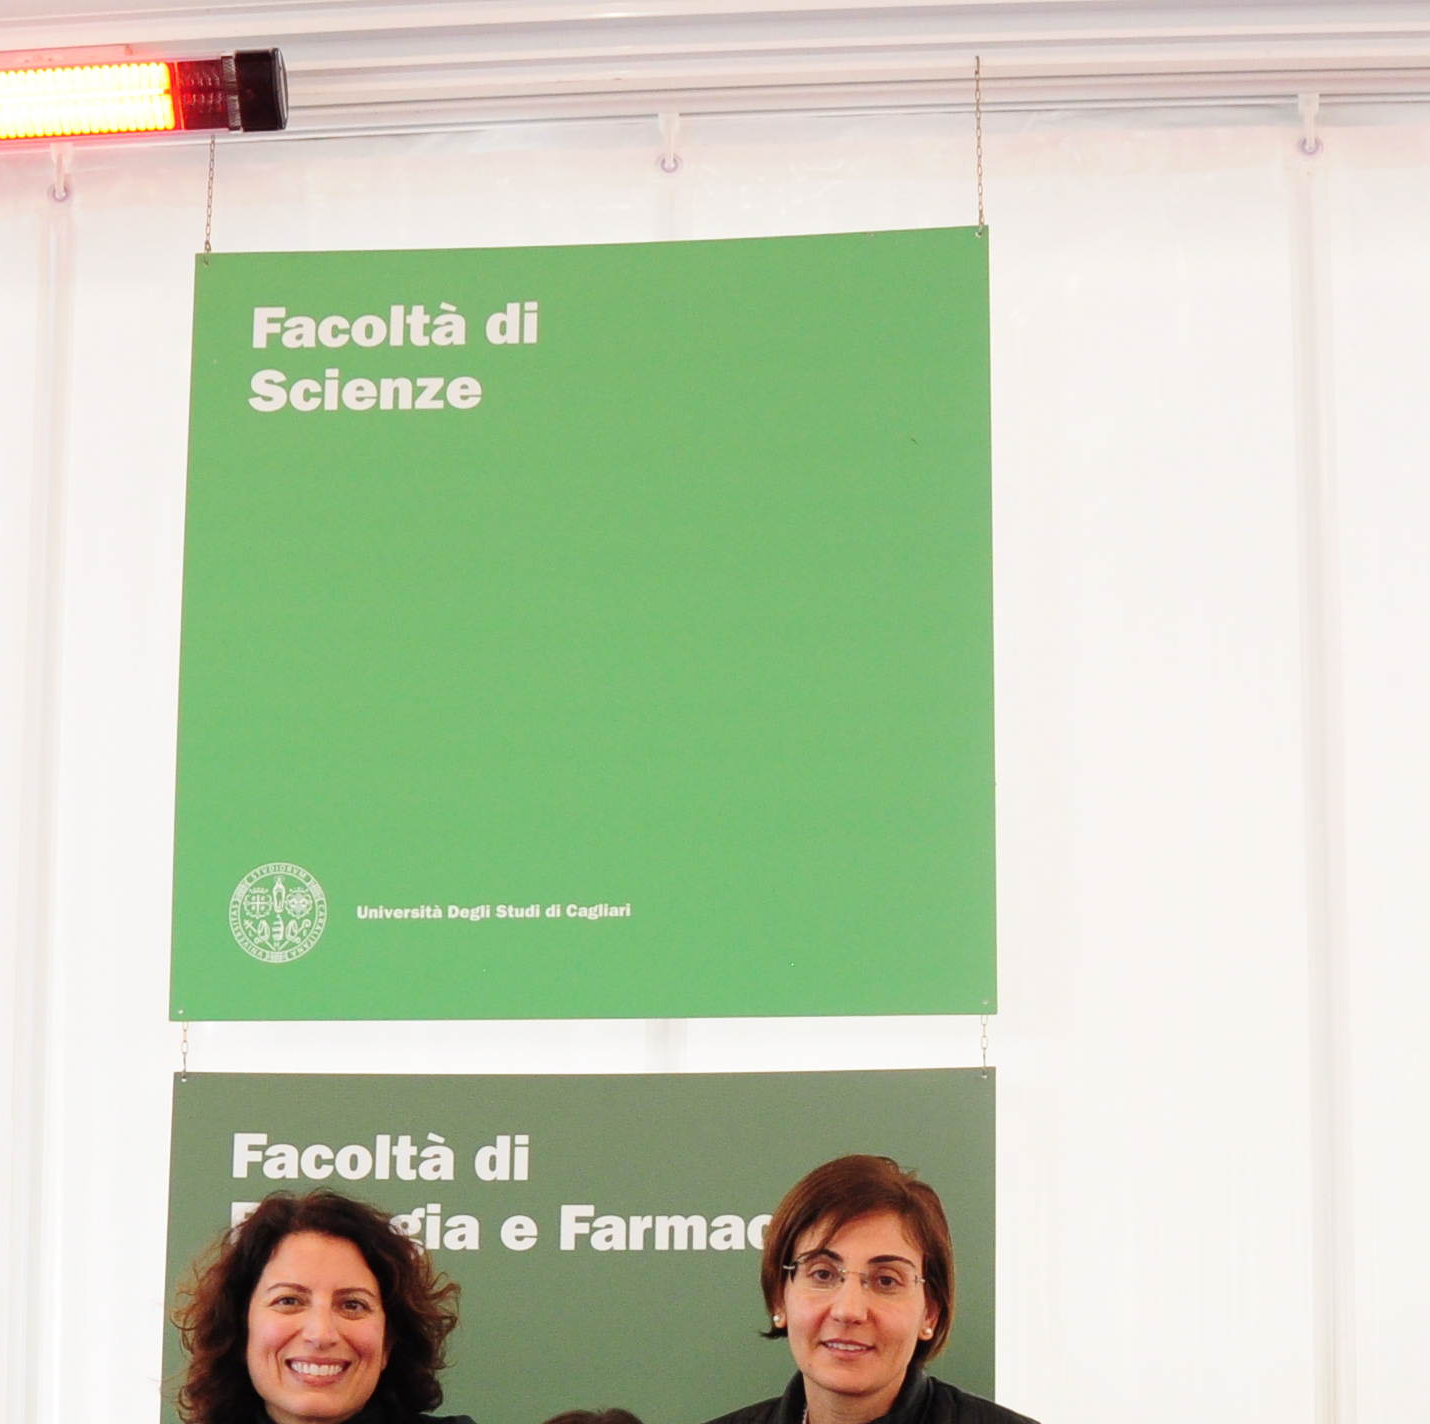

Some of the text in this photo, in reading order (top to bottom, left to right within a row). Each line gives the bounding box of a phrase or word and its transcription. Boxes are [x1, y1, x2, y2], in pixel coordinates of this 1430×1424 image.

[253, 301, 538, 348] Facoltà di
[248, 368, 482, 412] Scienze
[356, 903, 631, 922] Università Degli Studi di Cagliari
[232, 1132, 530, 1181] Facoltà di
[500, 1215, 538, 1251] e
[560, 1204, 773, 1251] Farmac
